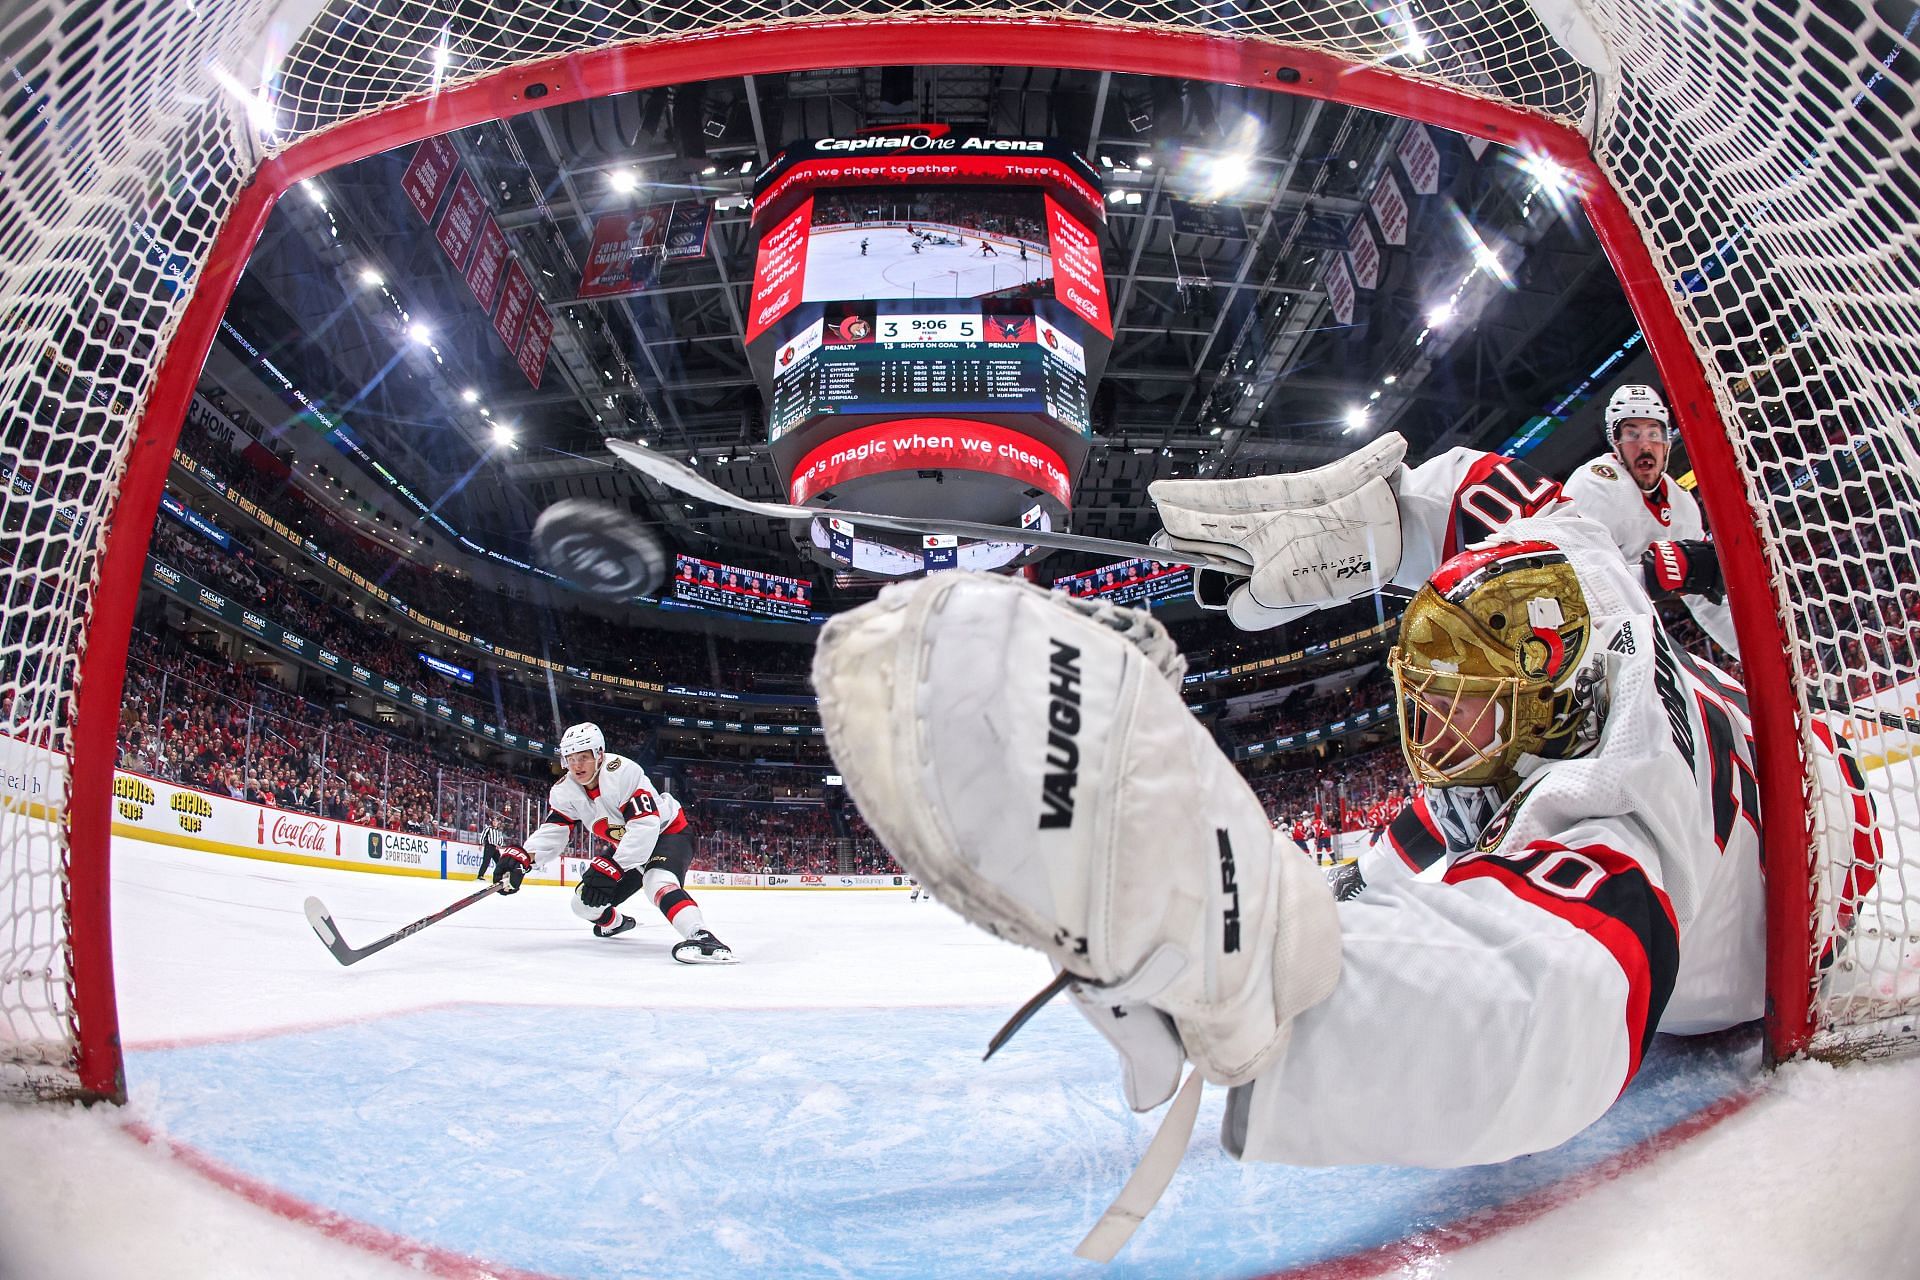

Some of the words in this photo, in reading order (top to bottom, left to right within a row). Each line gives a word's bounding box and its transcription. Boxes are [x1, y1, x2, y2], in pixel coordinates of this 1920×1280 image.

[961, 137, 1043, 151] Arena
[755, 189, 779, 214] magic
[781, 170, 812, 190] when
[817, 169, 839, 177] we
[844, 166, 886, 175] cheer
[890, 165, 957, 175] together
[1005, 165, 1060, 177] There's
[1063, 173, 1090, 200] magic
[768, 215, 802, 248] There's
[1055, 210, 1090, 245] There's
[769, 229, 798, 258] magic
[1054, 232, 1081, 259] when
[1081, 255, 1098, 272] we
[1060, 227, 1089, 255] magic
[761, 250, 787, 275] when
[788, 236, 804, 252] we
[1064, 252, 1092, 278] cheer
[766, 254, 794, 282] cheer
[1058, 258, 1101, 296] together
[757, 261, 801, 301] together
[883, 322, 898, 338] 3
[911, 320, 947, 330] 9:06
[960, 321, 974, 337] 5
[293, 389, 309, 405] DELL
[1631, 388, 1646, 396] 23
[200, 407, 236, 443] HOME
[781, 405, 812, 429] CAESARS
[1057, 408, 1086, 432] CAESARS
[180, 453, 198, 473] SEAT
[831, 440, 886, 467] magic
[893, 434, 954, 450] when
[960, 437, 992, 452] we
[998, 444, 1044, 469] cheer
[200, 466, 216, 480] CAESARS
[226, 487, 240, 505] BET
[239, 497, 258, 517] RIGHT
[256, 509, 273, 528] FROM
[273, 519, 289, 536] YOUR
[288, 530, 303, 547] SEAT
[154, 563, 181, 583] CAESARS
[327, 556, 338, 570] BET
[337, 563, 353, 579] RIGHT
[351, 572, 366, 588] FROM
[720, 563, 765, 580] WASHINGTON
[765, 573, 798, 586] CAPITALS
[1095, 558, 1139, 575] WASHINGTON
[1292, 555, 1364, 577] CATALYST
[1336, 561, 1372, 579] PX3
[200, 588, 225, 607] CAESARS
[243, 611, 266, 628] CAESARS
[408, 607, 418, 620] BET
[416, 613, 431, 627] RIGHT
[458, 631, 472, 644] SEAT
[282, 631, 304, 647] CAESARS
[1329, 639, 1340, 649] BET
[1339, 633, 1356, 645] RIGHT
[1622, 621, 1636, 655] adidas
[319, 650, 339, 664] CAESARS
[494, 646, 504, 656] BET
[504, 649, 521, 661] RIGHT
[521, 654, 536, 665] FROM
[537, 658, 551, 669] YOUR
[551, 662, 565, 673] SEAT
[1231, 666, 1241, 675] BET
[1242, 661, 1258, 672] RIGHT
[1258, 658, 1276, 668] FROM
[1275, 654, 1291, 665] YOUR
[1290, 650, 1304, 661] SEAT
[352, 665, 371, 679] CAESARS
[590, 672, 601, 681] BET
[602, 674, 619, 684] RIGHT
[619, 677, 635, 687] FROM
[635, 680, 650, 690] YOUR
[650, 683, 664, 692] SEAT
[384, 680, 400, 692] CAESARS
[412, 693, 427, 704] CAESARS
[1039, 637, 1082, 830] VAUGHN
[118, 800, 143, 821] FENCE
[169, 791, 213, 819] HERCULES
[629, 793, 653, 816] 18
[179, 813, 202, 833] FENCE
[272, 815, 328, 852] Coca-Cola
[385, 834, 429, 855] CAESARS
[385, 850, 422, 865] SPORTSBOOK
[800, 875, 824, 883] DEX
